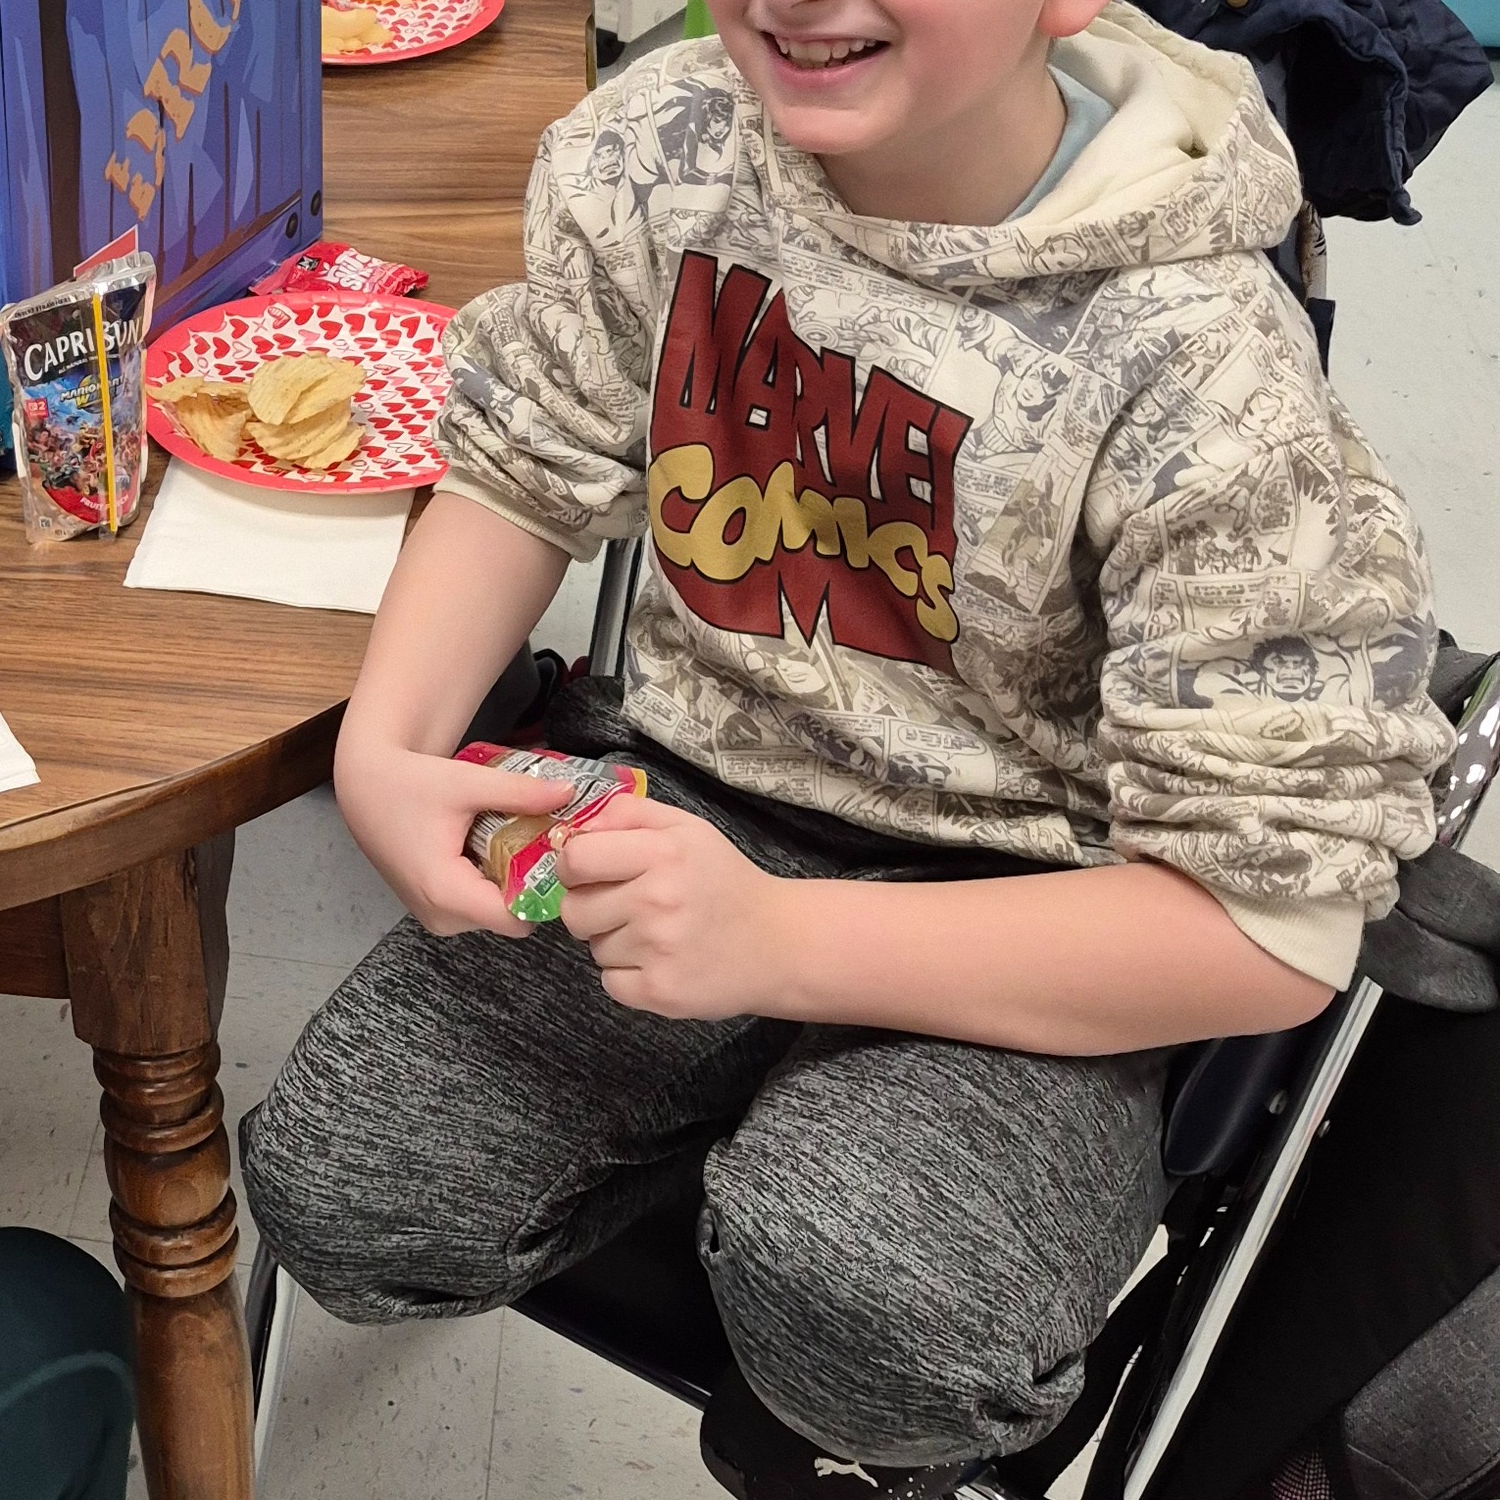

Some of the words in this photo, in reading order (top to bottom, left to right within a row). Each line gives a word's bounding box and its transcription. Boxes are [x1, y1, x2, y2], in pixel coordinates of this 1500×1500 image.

[24, 327, 95, 381] CAPRI
[101, 315, 141, 352] SUN
[647, 444, 960, 643] COMICS
